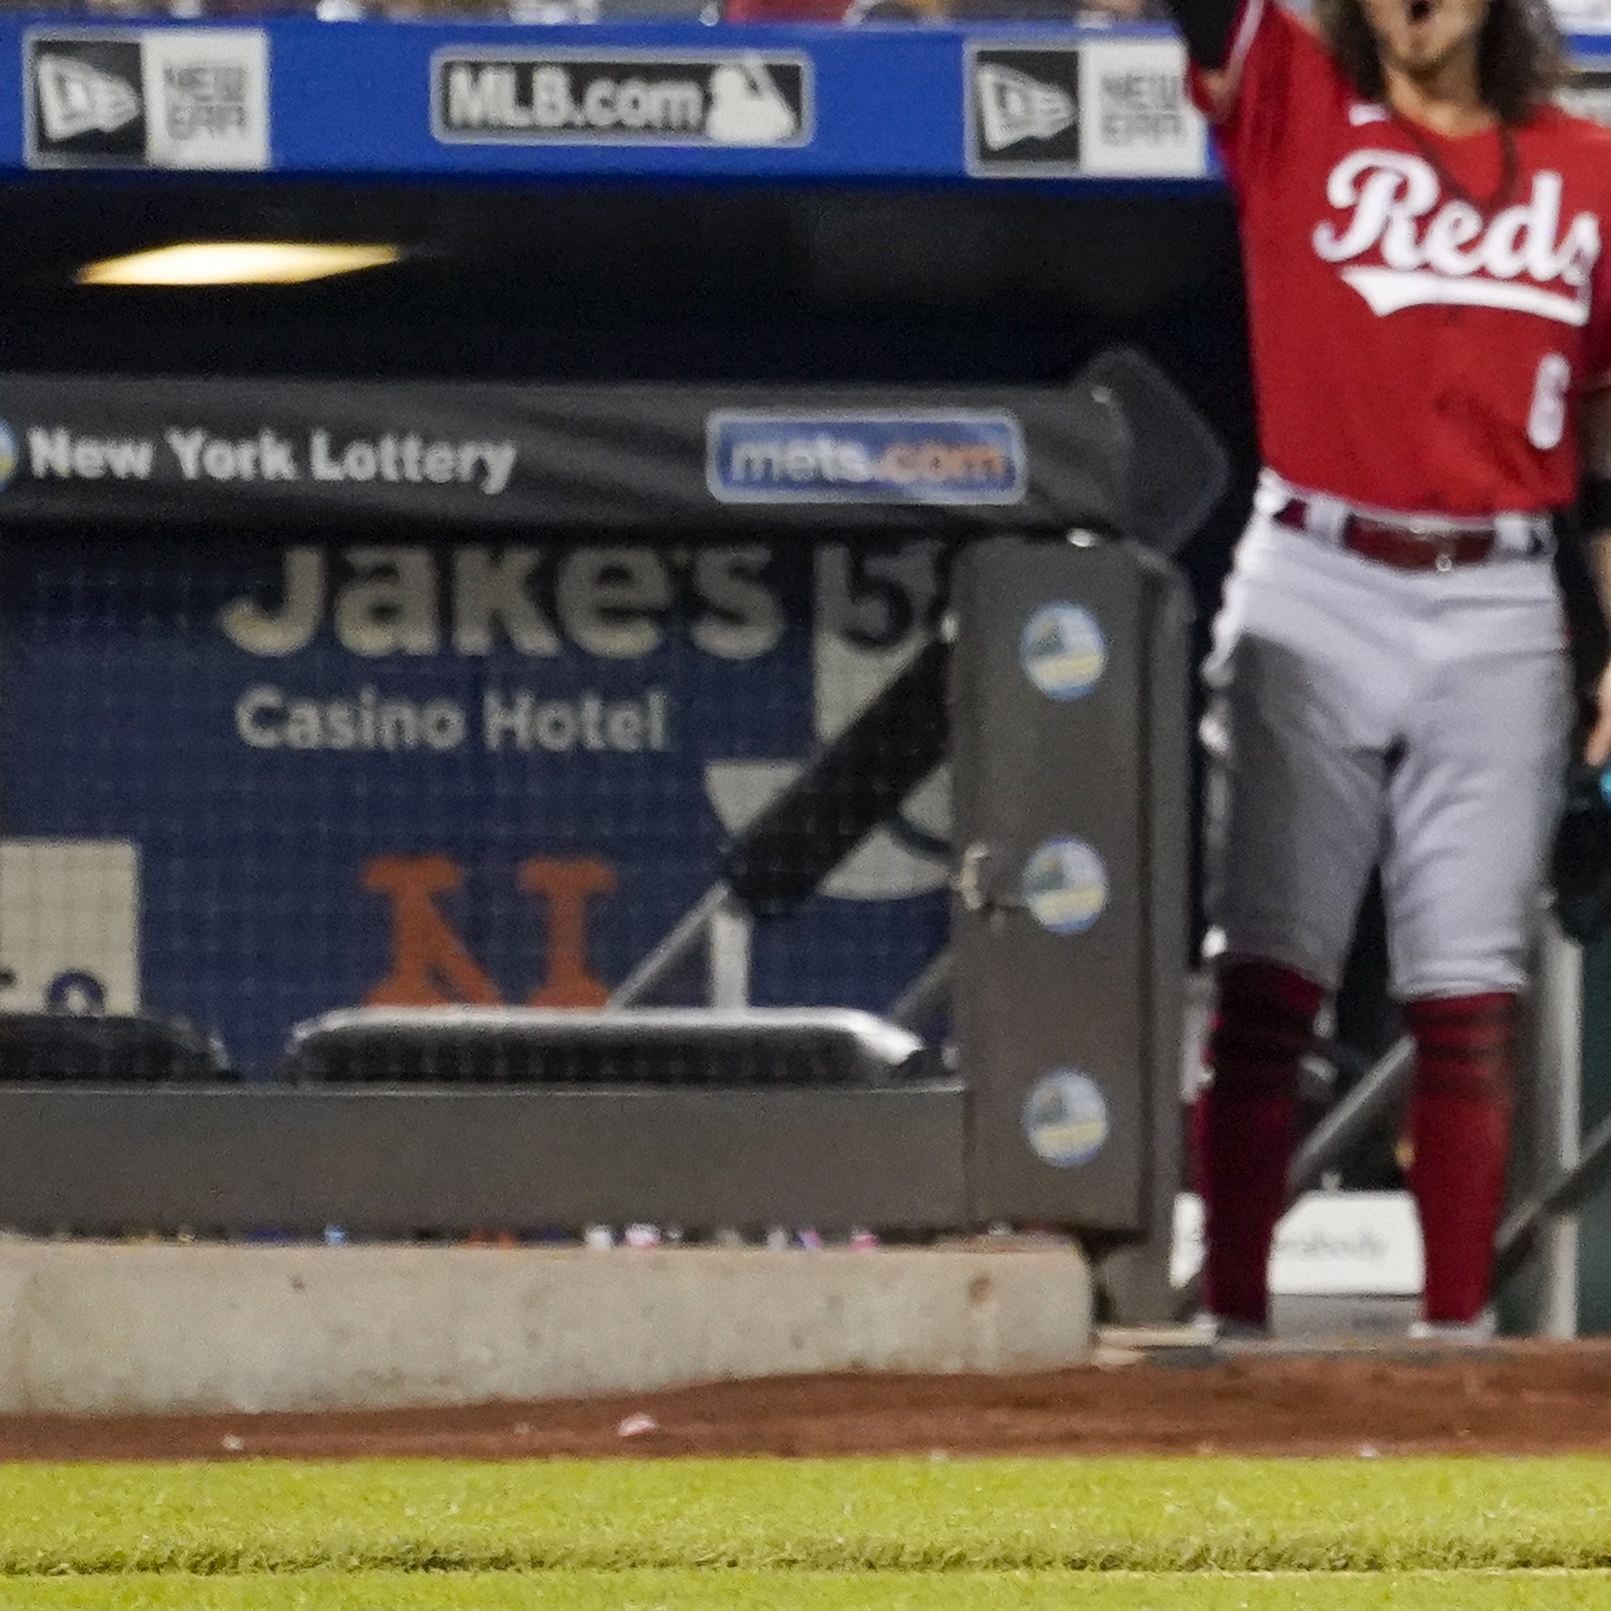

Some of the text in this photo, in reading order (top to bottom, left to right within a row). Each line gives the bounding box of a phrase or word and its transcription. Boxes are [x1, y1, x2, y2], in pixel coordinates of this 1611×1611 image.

[448, 64, 701, 129] MLB.com
[1312, 149, 1600, 286] Reds
[27, 426, 517, 495] New York Lottery
[730, 429, 1008, 484] mets.com
[234, 686, 667, 752] Casino Hotel
